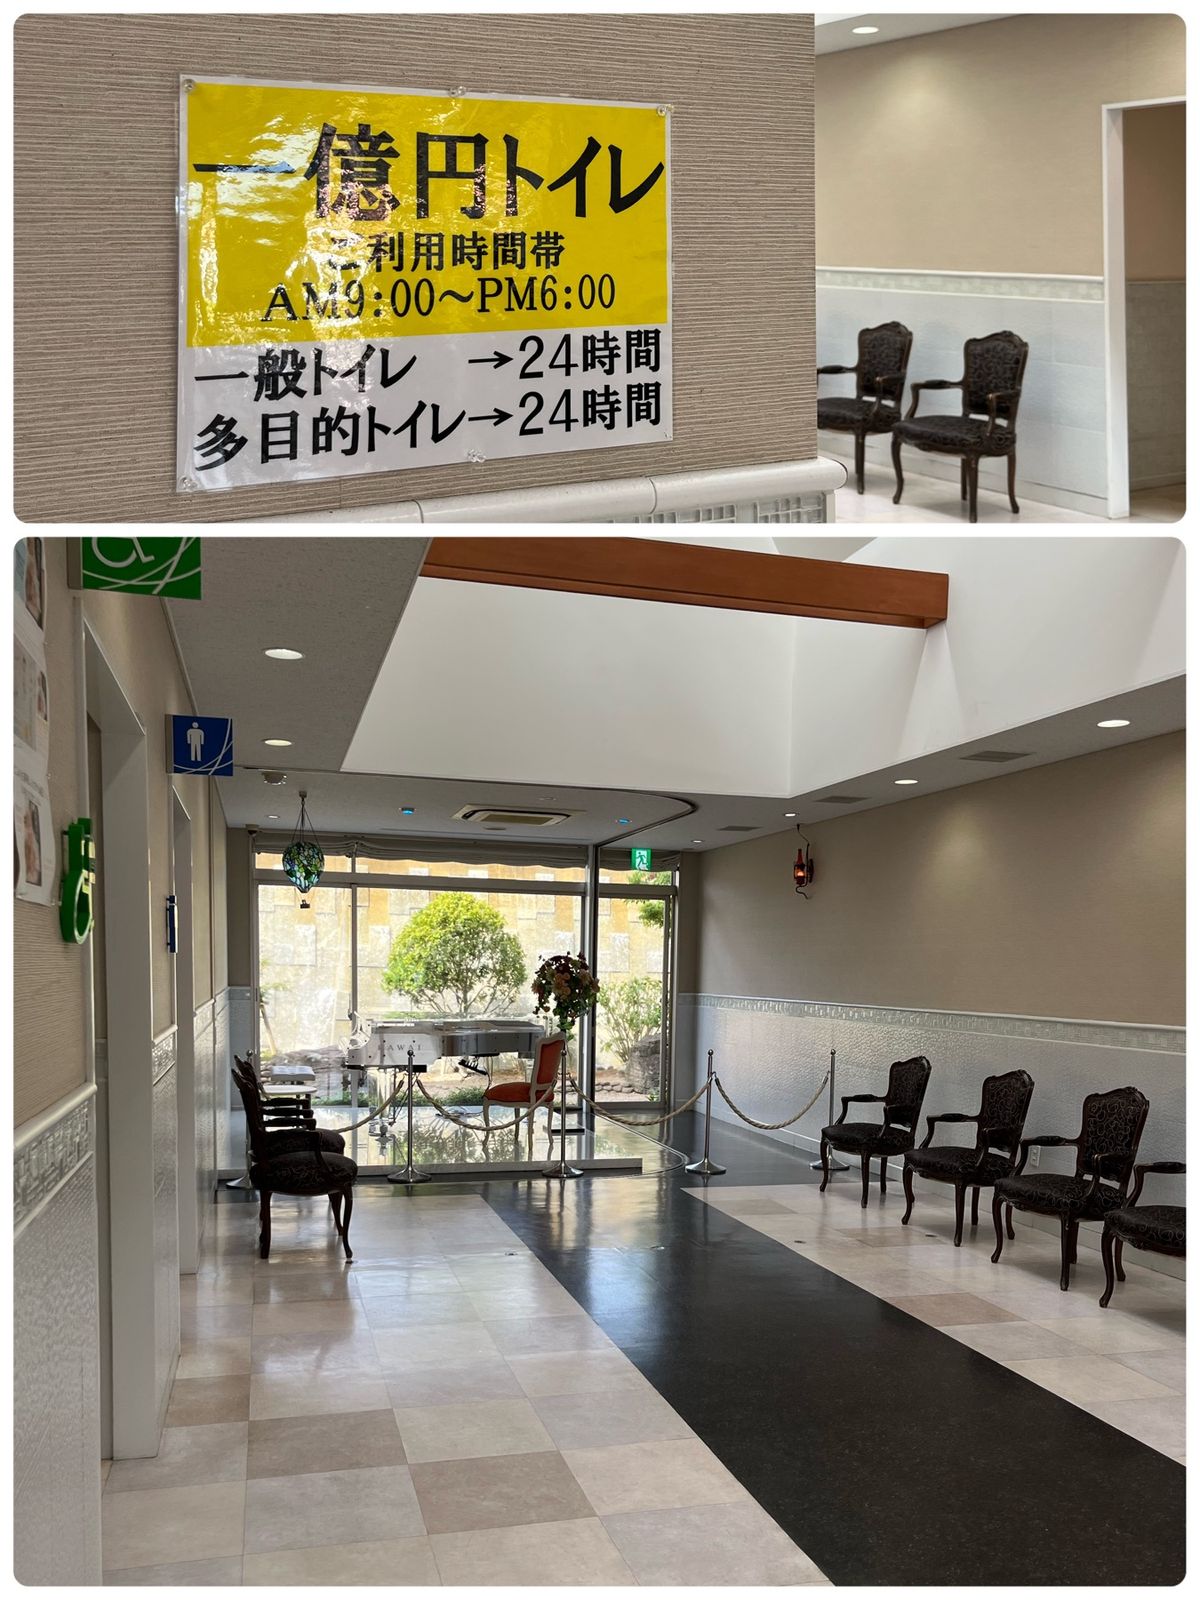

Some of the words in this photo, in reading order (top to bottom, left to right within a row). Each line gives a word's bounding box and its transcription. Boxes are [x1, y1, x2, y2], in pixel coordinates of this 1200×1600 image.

[193, 123, 665, 221] 一億円トイレ
[194, 344, 417, 402] 一般トイレ
[518, 328, 662, 380] 24時間
[194, 400, 467, 472] 多目的トイレ
[518, 381, 662, 437] 24時間
